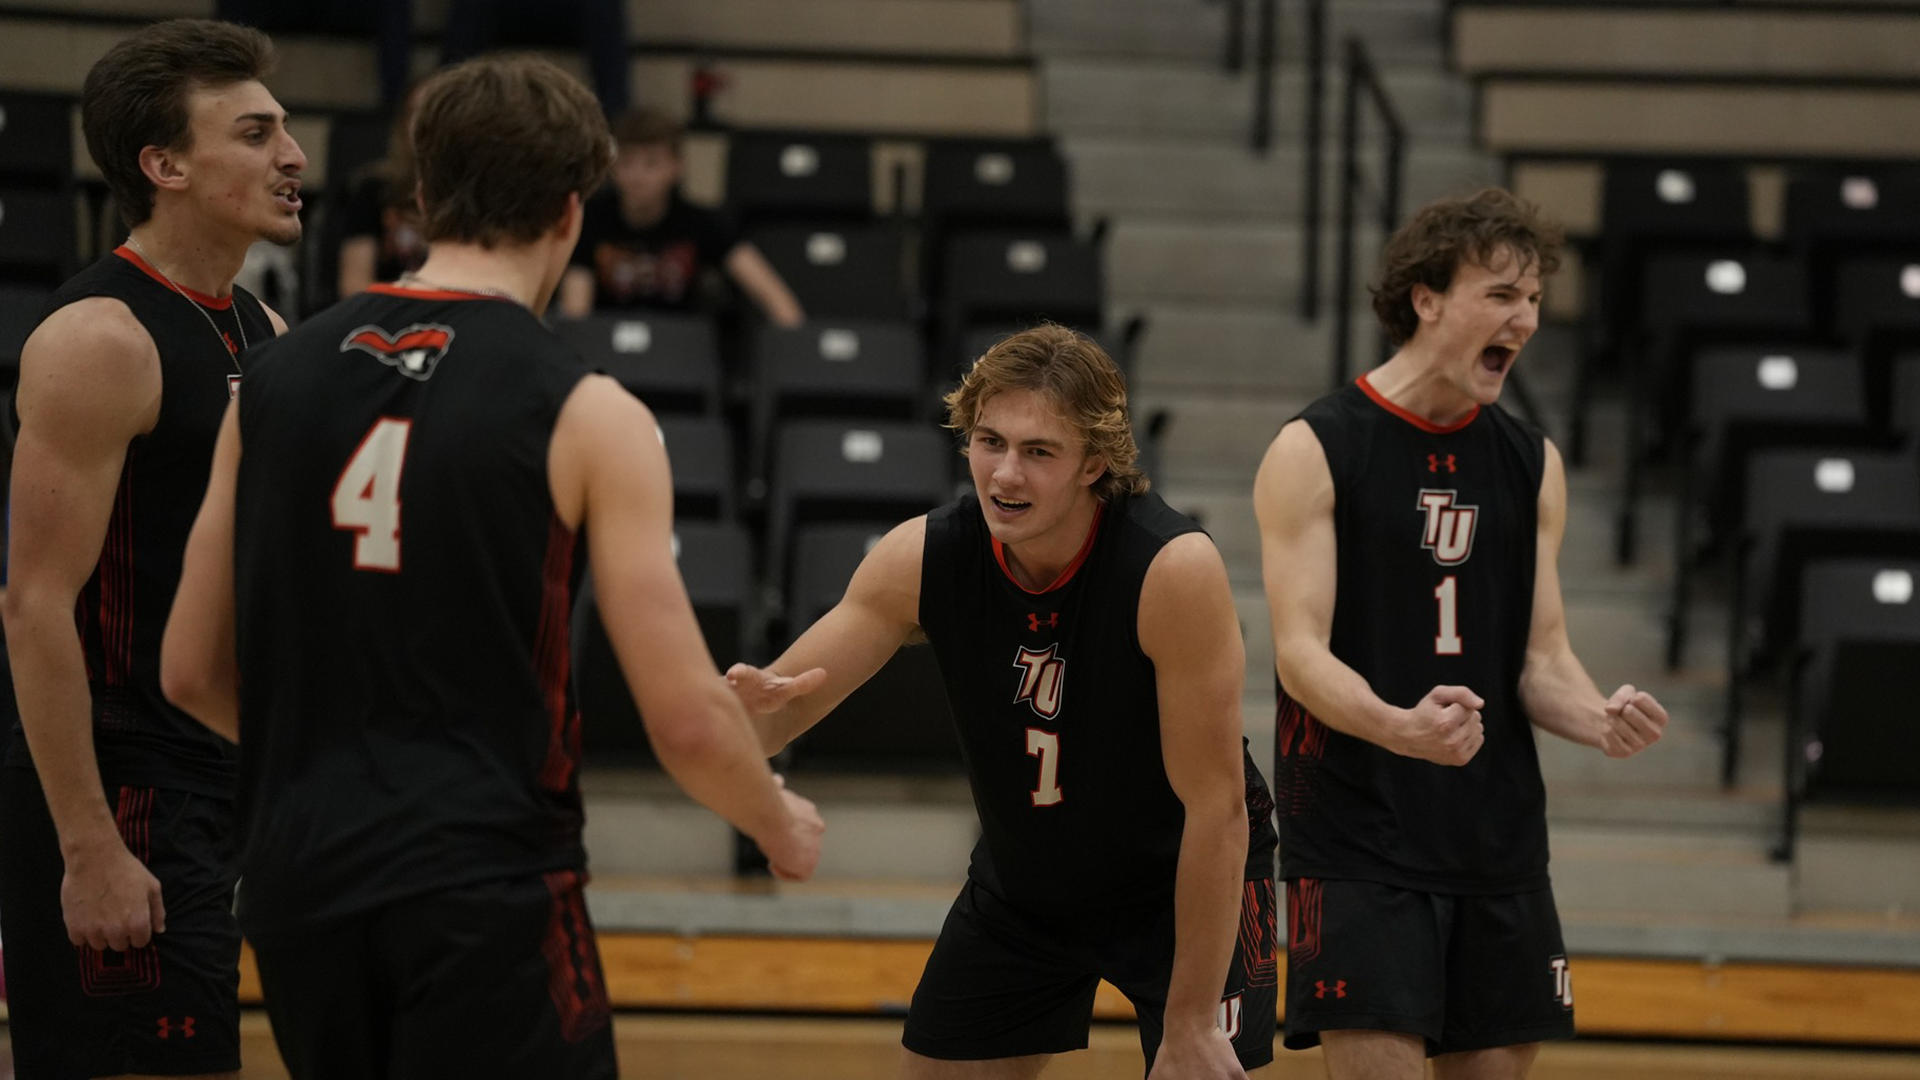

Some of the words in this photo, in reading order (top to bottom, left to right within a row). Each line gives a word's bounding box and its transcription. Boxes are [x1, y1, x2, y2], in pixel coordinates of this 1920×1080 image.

[330, 416, 413, 573] 4
[1416, 488, 1479, 566] TU
[1434, 576, 1463, 655] 1
[1013, 643, 1066, 720] TU
[1025, 727, 1064, 807] 7
[1217, 989, 1245, 1043] U
